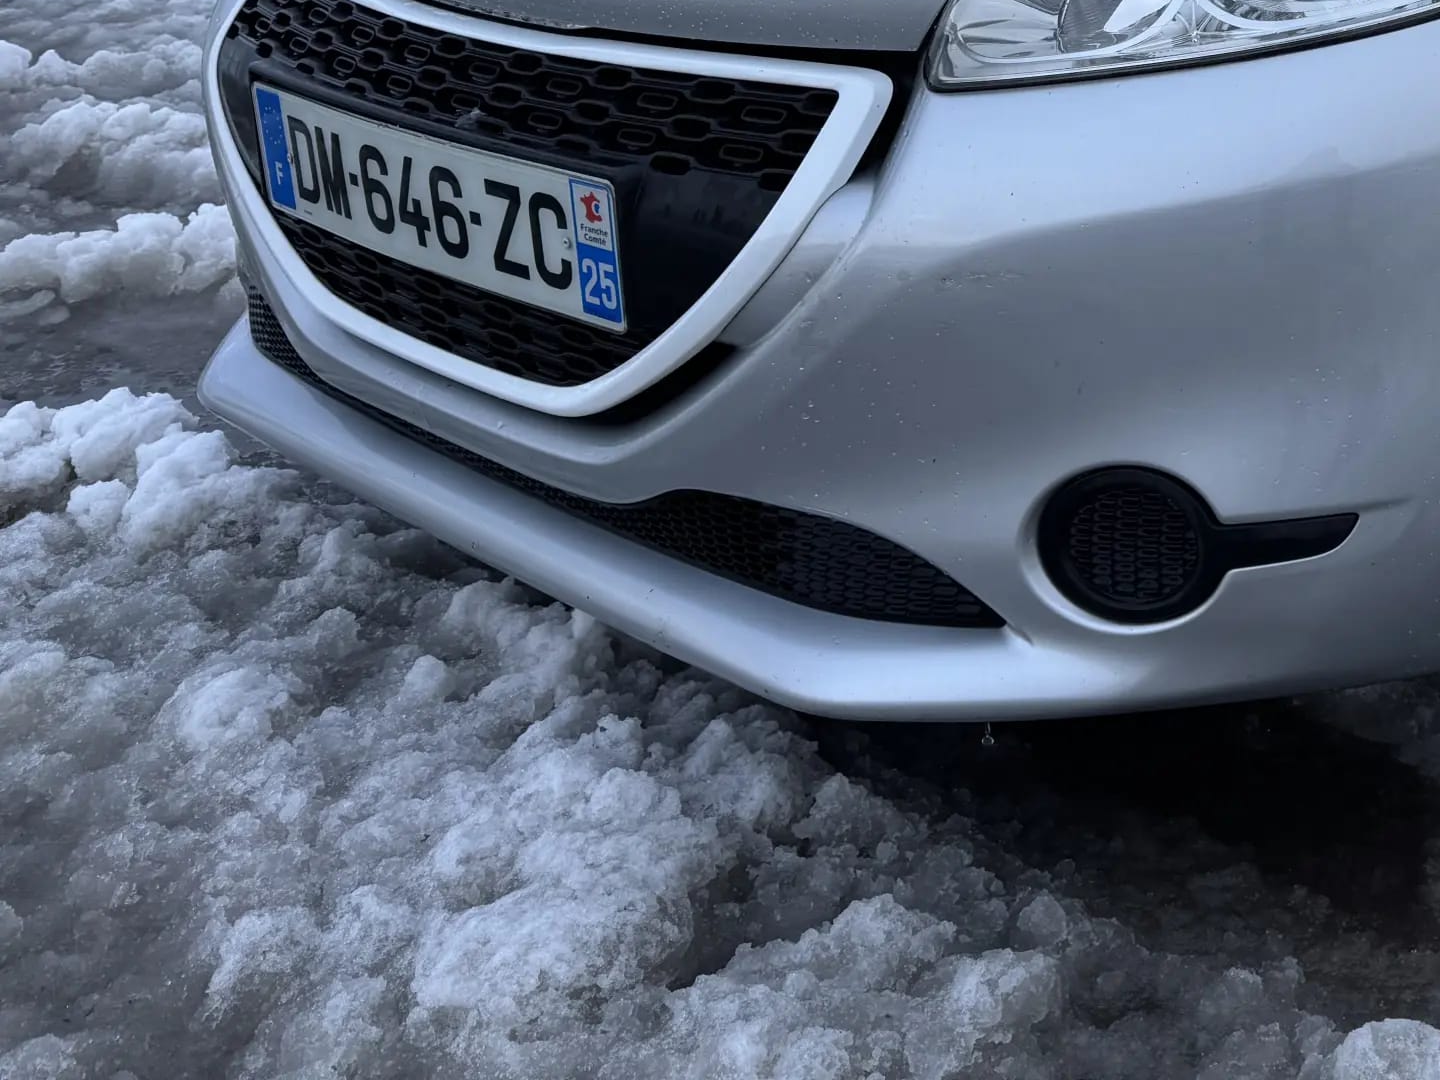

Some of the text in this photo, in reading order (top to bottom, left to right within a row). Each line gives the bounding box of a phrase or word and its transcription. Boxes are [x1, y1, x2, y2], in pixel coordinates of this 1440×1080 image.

[274, 161, 284, 185] F
[286, 115, 573, 291] DM-646-ZC
[580, 223, 609, 238] Franche
[581, 258, 617, 310] 25
